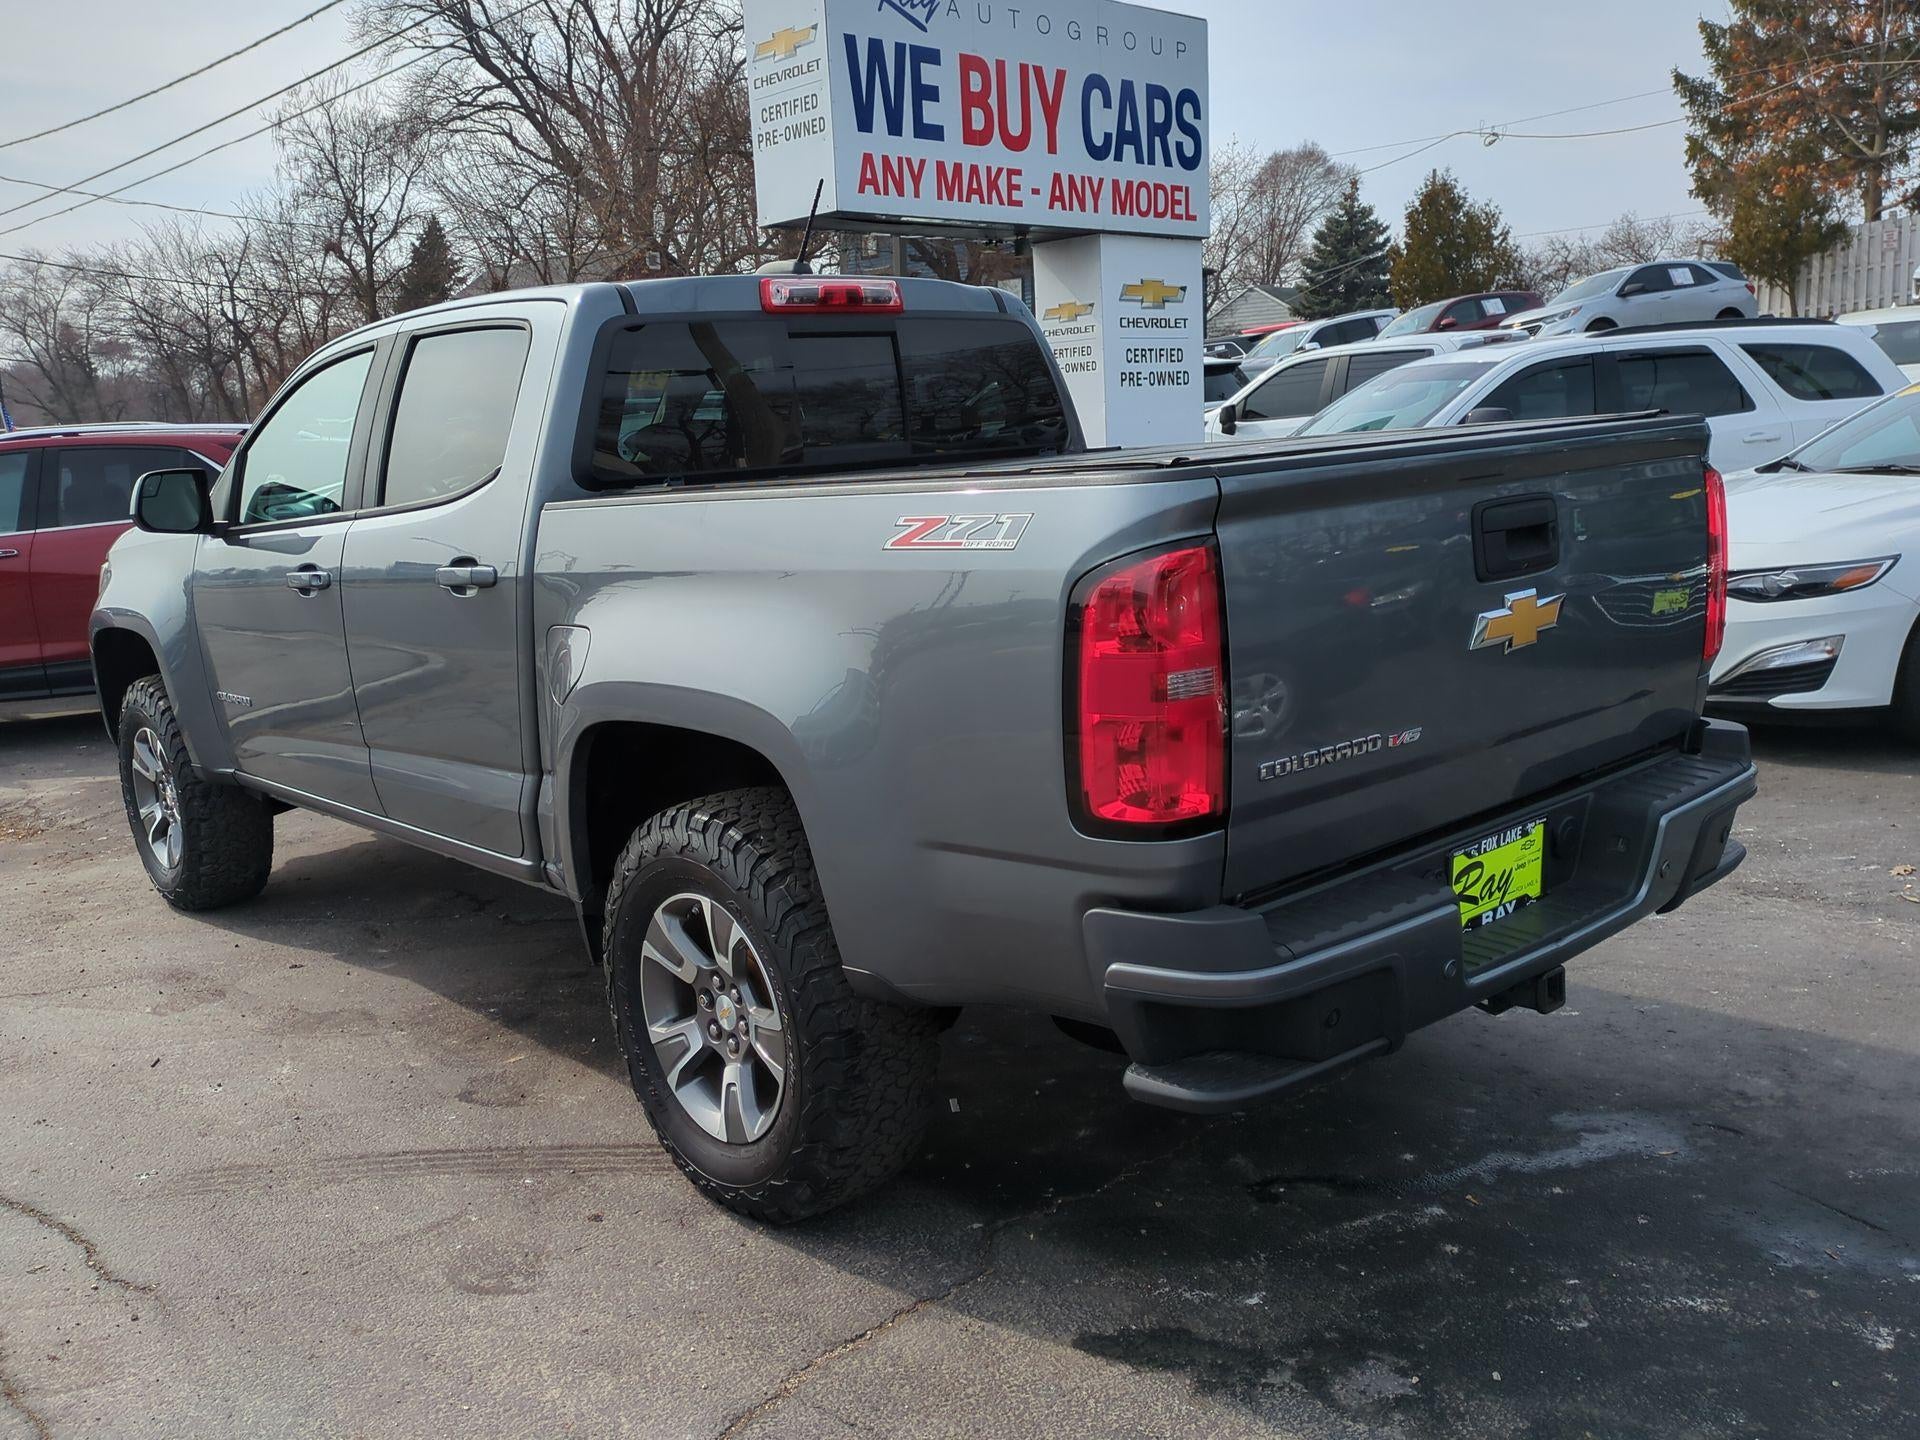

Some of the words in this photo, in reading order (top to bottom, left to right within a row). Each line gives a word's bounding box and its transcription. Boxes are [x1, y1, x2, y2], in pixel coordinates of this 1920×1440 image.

[753, 58, 822, 90] CHEVROLET
[761, 93, 818, 124] CERTIFIED
[843, 33, 945, 142] WE
[958, 52, 1067, 155] BUY
[1081, 73, 1202, 171] CARS
[757, 116, 826, 149] PRE-OWNED
[857, 152, 927, 199] ANY
[935, 160, 1023, 208] MAKE
[1048, 172, 1104, 214] ANY
[1111, 178, 1197, 222] MODEL
[1043, 325, 1096, 338] CHEVROLET
[1119, 317, 1189, 329] CHEVROLET
[1053, 345, 1092, 359] ERTIFIED
[1059, 360, 1097, 374] -OWNED
[1125, 348, 1184, 364] CERTIFIED
[1120, 371, 1190, 388] PRE-OWNED
[882, 512, 1035, 551] Z71
[1259, 733, 1382, 781] COLORADO
[1387, 727, 1423, 748] V6
[1481, 835, 1499, 854] FOX
[1500, 826, 1522, 847] LAKE
[1453, 860, 1515, 907] Ray
